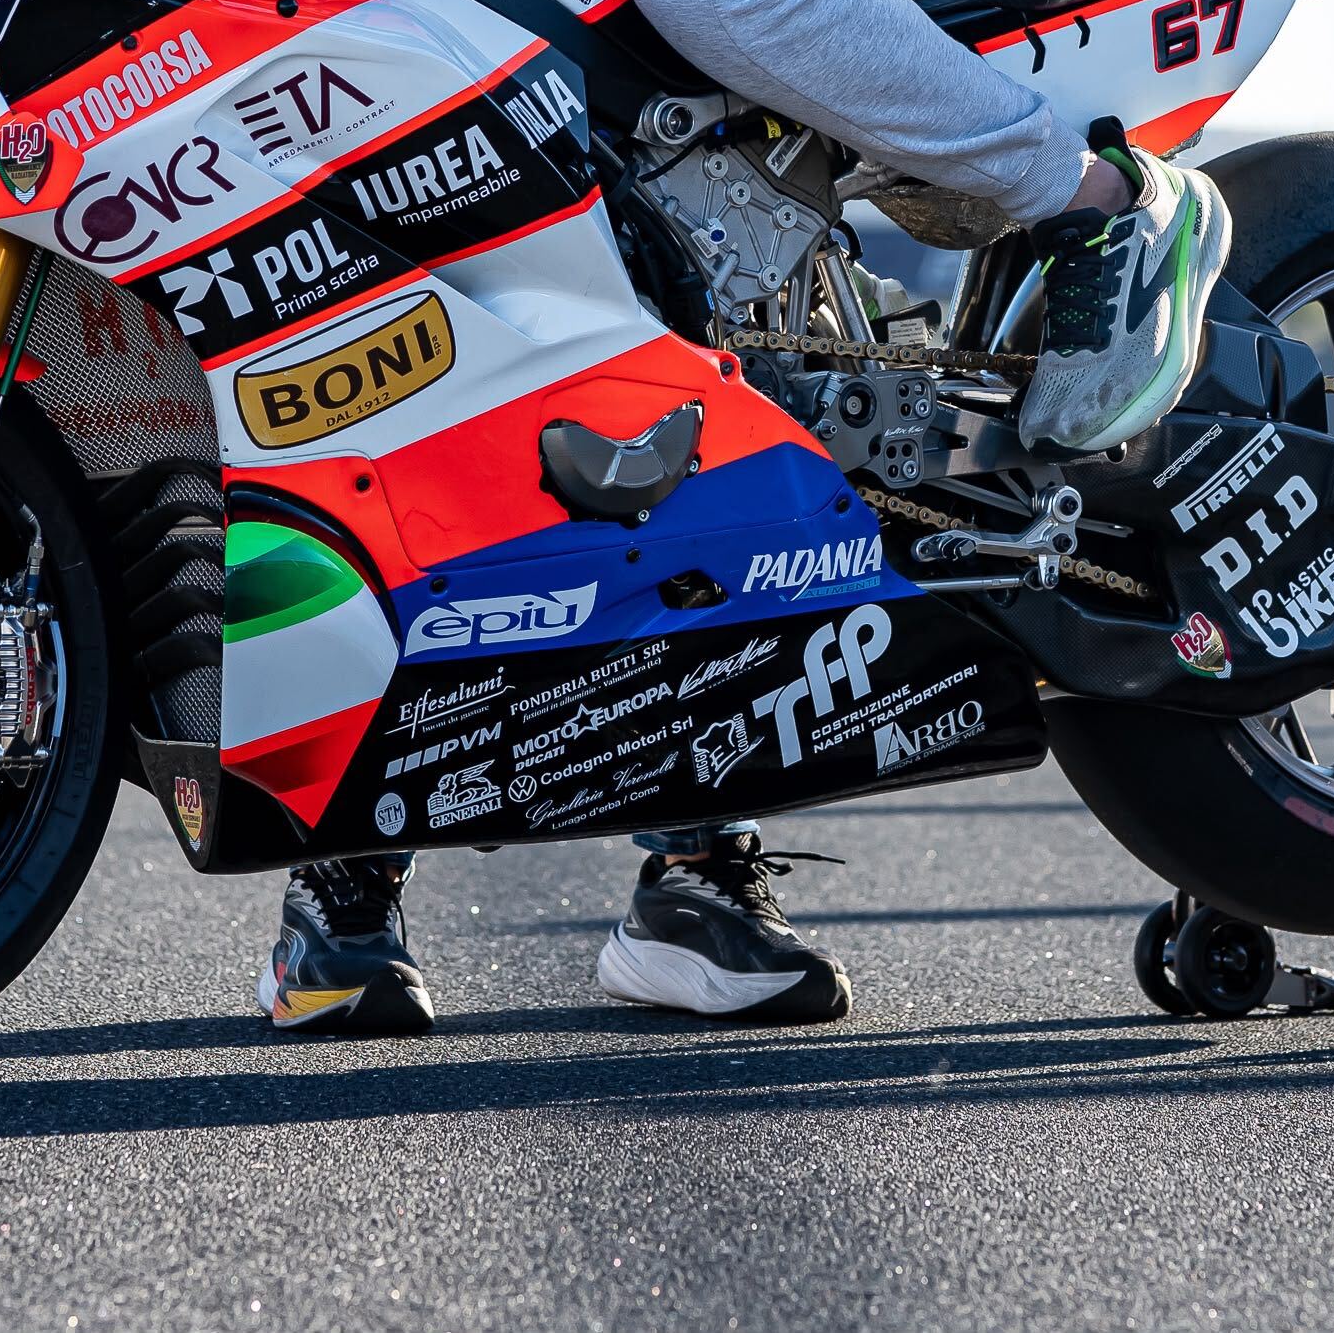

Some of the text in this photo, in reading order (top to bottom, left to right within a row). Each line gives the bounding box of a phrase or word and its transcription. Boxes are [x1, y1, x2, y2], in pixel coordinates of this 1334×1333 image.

[46, 29, 213, 149] OTOCORSA
[506, 69, 585, 150] ITALIA
[0, 122, 47, 164] H2O
[268, 100, 396, 169] ARREDAMENTI CONTRACT
[397, 165, 522, 227] impermeabile
[1193, 201, 1203, 236] BROOKS
[275, 252, 380, 320] Prima scelta
[431, 334, 442, 356] spa
[259, 320, 436, 429] BONI
[326, 392, 392, 427] DAL 1912
[1170, 423, 1285, 533] PIRELLI
[742, 534, 883, 596] PADANIA
[803, 577, 879, 597] ALIMENTI
[1171, 611, 1212, 661] H2O
[25, 646, 38, 726] brembo
[399, 666, 504, 732] Effesalumi
[510, 639, 670, 716] FONDERIA BUTTI SRL
[522, 705, 549, 724] fusioni
[550, 701, 559, 710] in
[559, 685, 597, 707] alluminio
[603, 663, 646, 688] Valmadrera
[732, 713, 749, 752] COLOMBO
[811, 684, 911, 741] COSTRUZIONE
[813, 664, 979, 754] NASTRI TRASPORTATORI
[441, 721, 502, 759] PVM
[515, 745, 566, 772] DUCATI
[540, 715, 694, 786] Codogno Motori Srl
[694, 750, 711, 783] ORIGGI
[922, 738, 961, 758] DYNAMIC
[963, 725, 986, 739] WEAR
[175, 776, 202, 816] H2O
[377, 802, 404, 826] STM
[429, 796, 503, 829] GENERALI
[526, 750, 680, 830] Gioielleria Veronelli
[551, 813, 588, 831] Lurago
[589, 799, 621, 817] d'erba
[629, 785, 660, 801] Como
